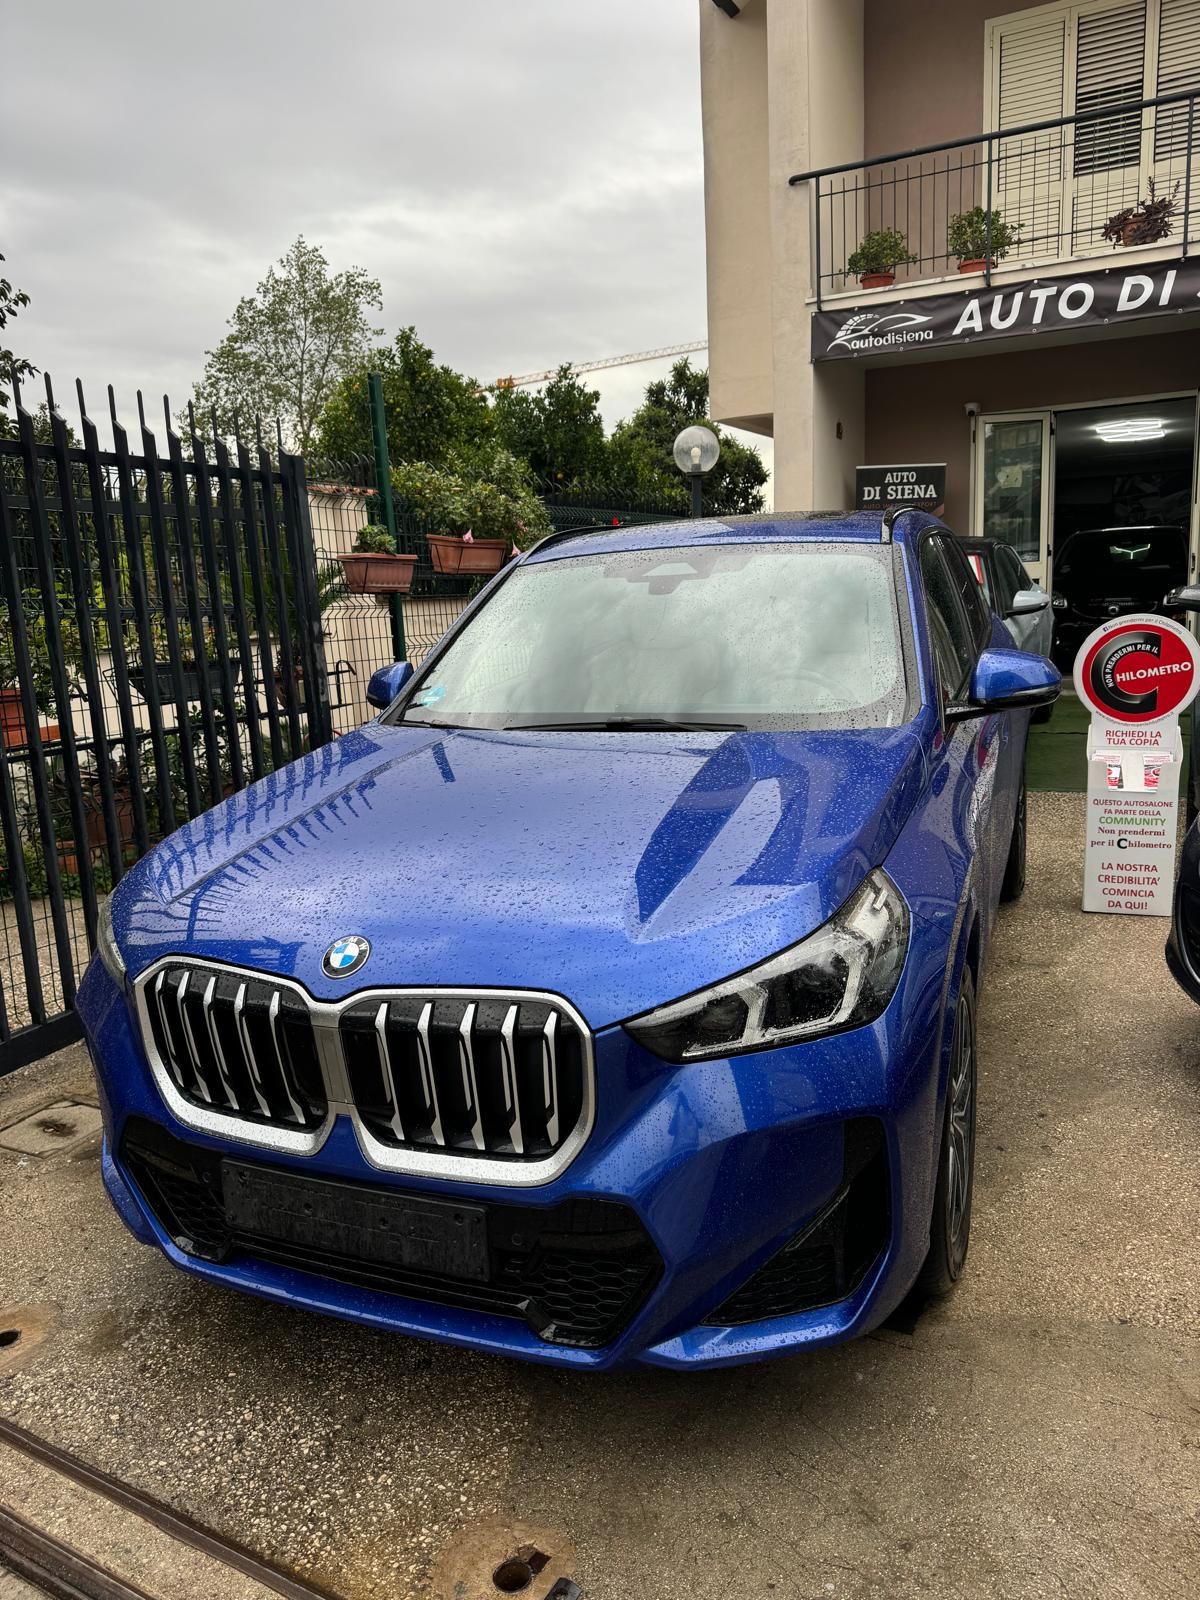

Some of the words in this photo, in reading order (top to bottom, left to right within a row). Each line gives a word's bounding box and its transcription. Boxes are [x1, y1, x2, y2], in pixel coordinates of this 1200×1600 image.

[952, 283, 1095, 336] AUTO
[1116, 270, 1177, 312] DI
[851, 330, 933, 349] autodisiena
[884, 472, 917, 483] AUTO
[863, 486, 881, 501] DI
[887, 484, 937, 500] SIENA
[1105, 730, 1147, 738] RICHIEDI
[1150, 731, 1162, 739] LA
[1107, 737, 1127, 746] TUA
[1129, 738, 1160, 746] COPIA
[1092, 798, 1123, 807] QUESTO
[1123, 800, 1174, 808] AUTOSALONE
[1138, 809, 1161, 817] DELLA
[1099, 816, 1166, 826] COMMUNITY
[1097, 826, 1116, 835] Non
[1118, 828, 1166, 837] prendermi
[1090, 840, 1106, 848] per
[1116, 837, 1173, 850] Chilometro
[1101, 862, 1114, 871] LA
[1116, 863, 1158, 873] NOSTRA
[1102, 887, 1155, 898] COMINCIA
[1107, 900, 1122, 909] DA
[1124, 901, 1148, 910] QUI!
